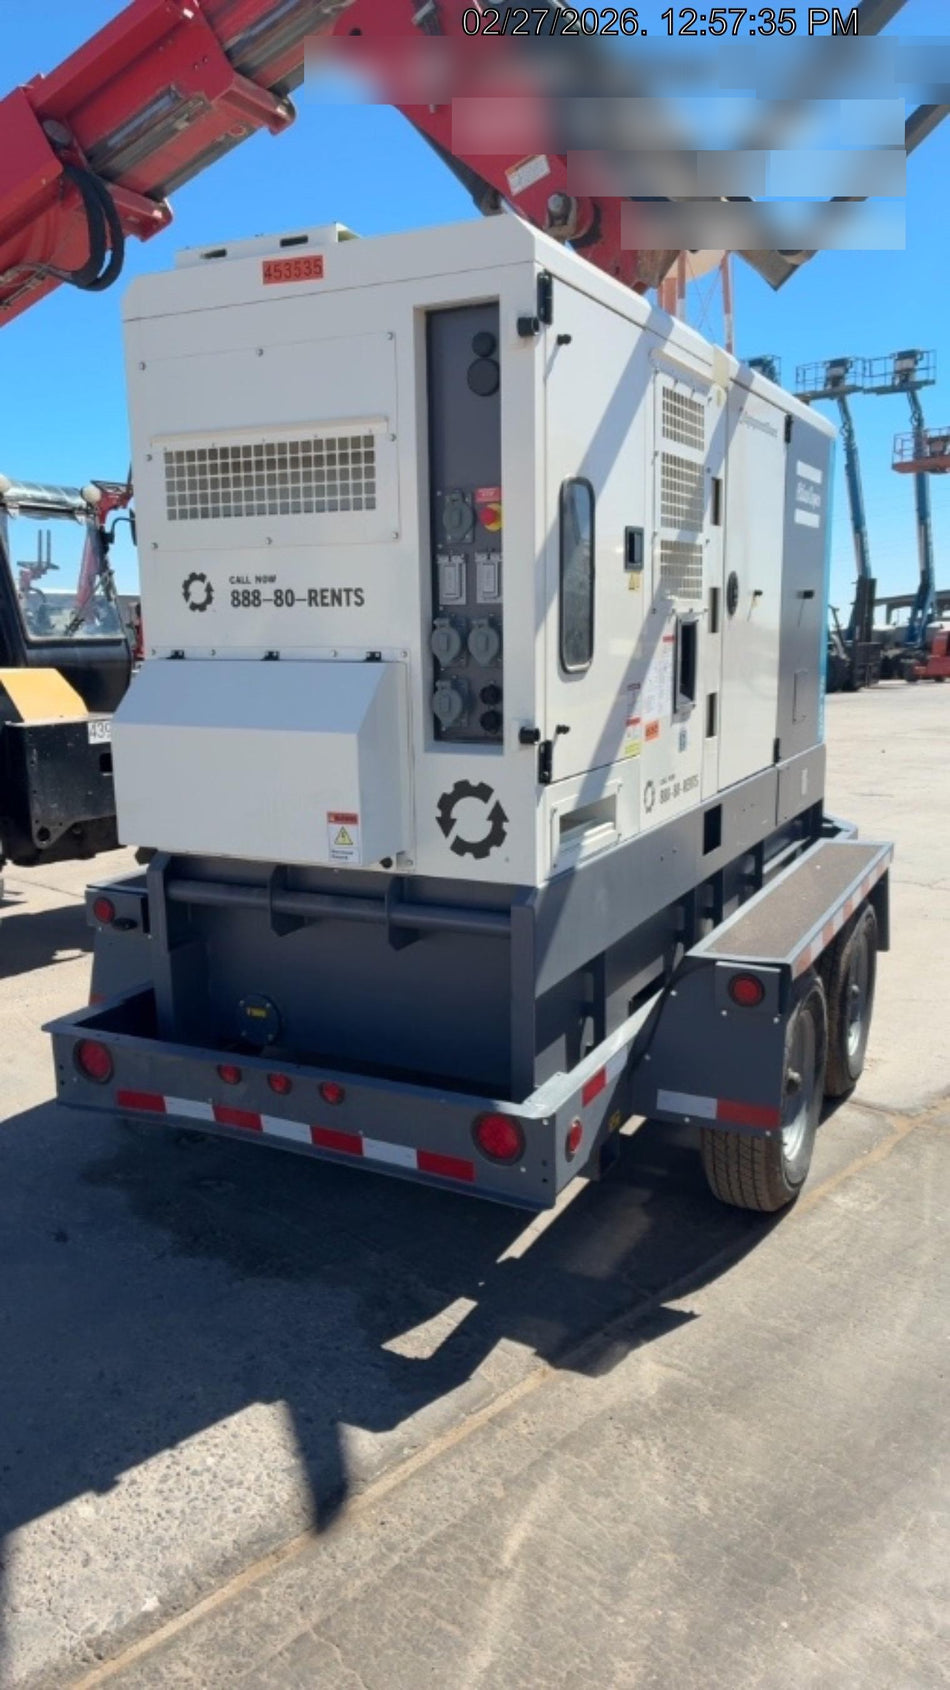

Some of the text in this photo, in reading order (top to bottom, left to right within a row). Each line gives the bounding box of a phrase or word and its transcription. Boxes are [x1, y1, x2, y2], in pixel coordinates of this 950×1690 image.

[264, 258, 323, 280] 453535
[228, 574, 277, 585] CALL NOW
[230, 587, 366, 608] 888-80-RENTS
